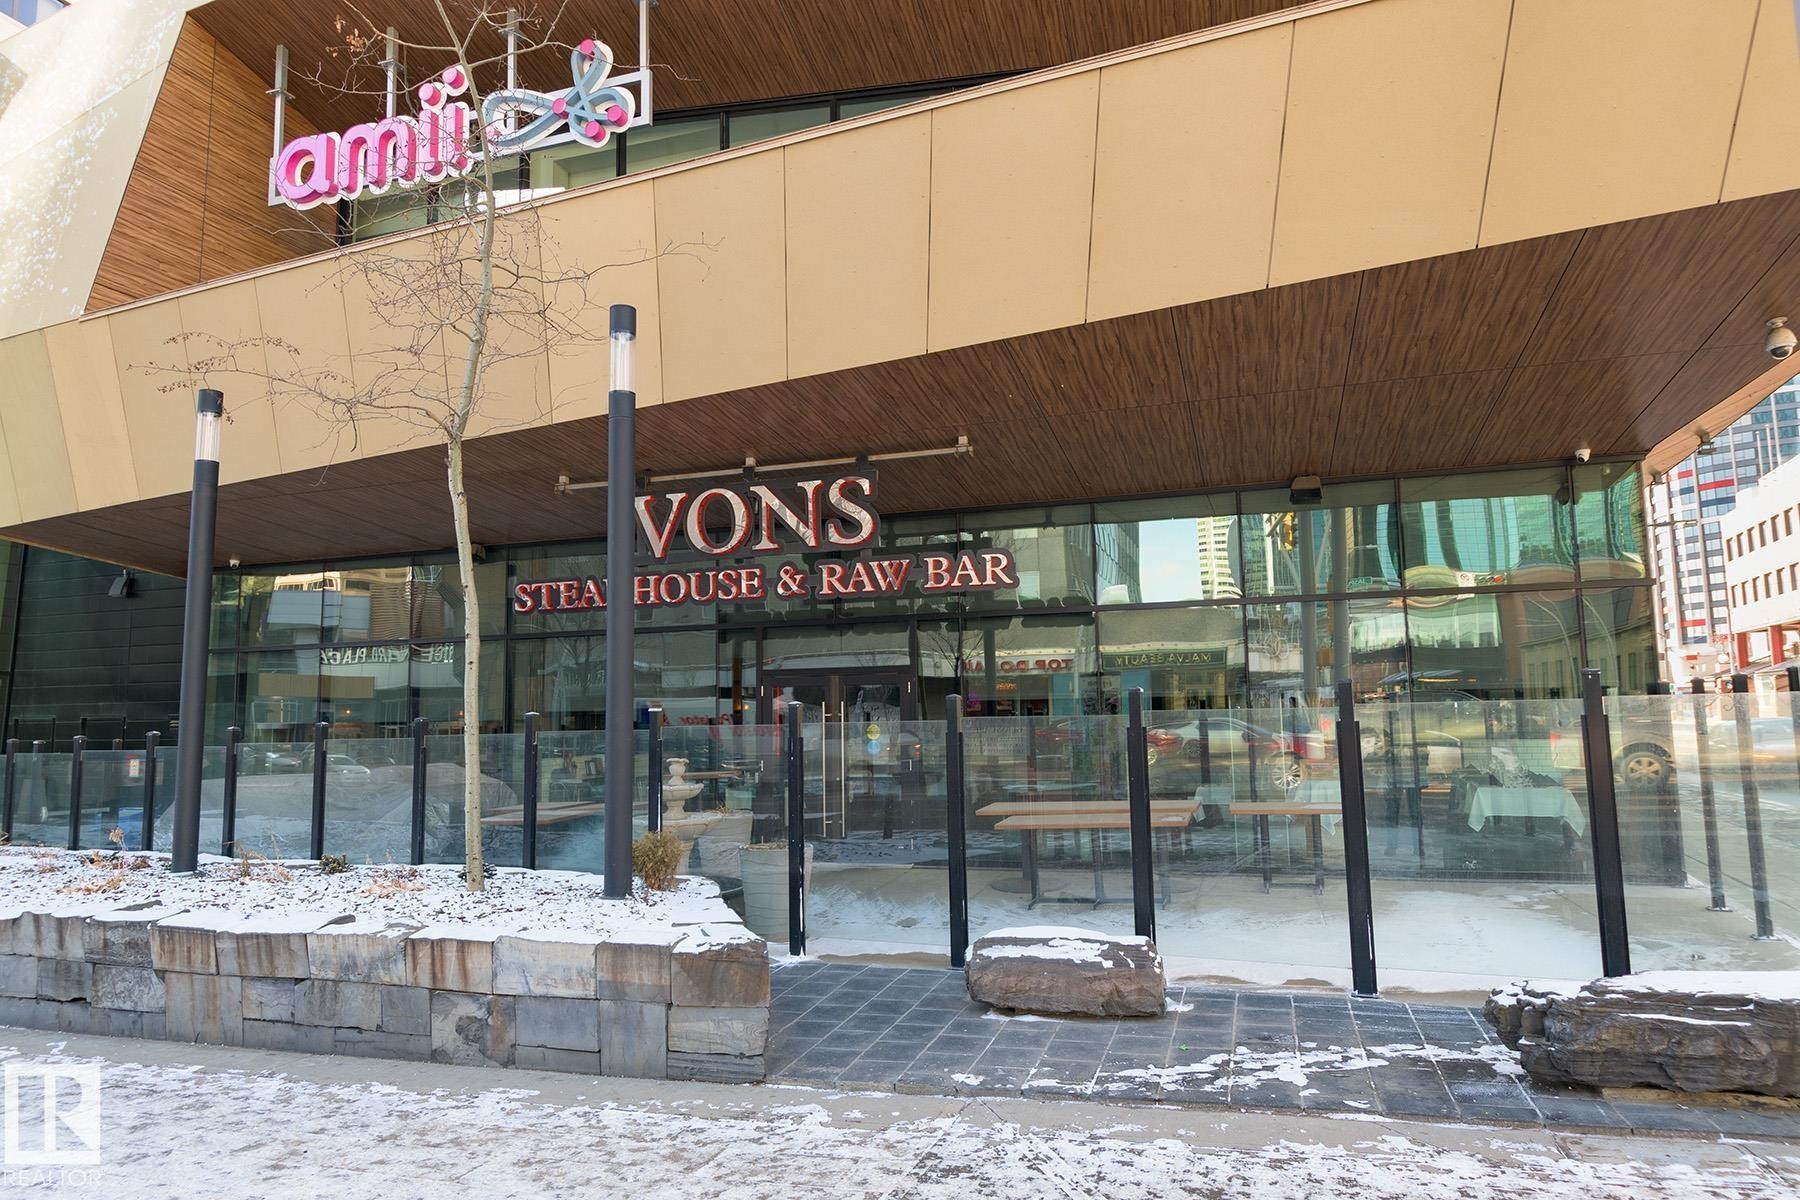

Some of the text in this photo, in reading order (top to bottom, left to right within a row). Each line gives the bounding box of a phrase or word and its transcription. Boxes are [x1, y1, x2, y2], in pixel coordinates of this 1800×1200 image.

[634, 475, 875, 559] VONS
[514, 552, 1015, 613] STEAHOUSE & RAW BAR
